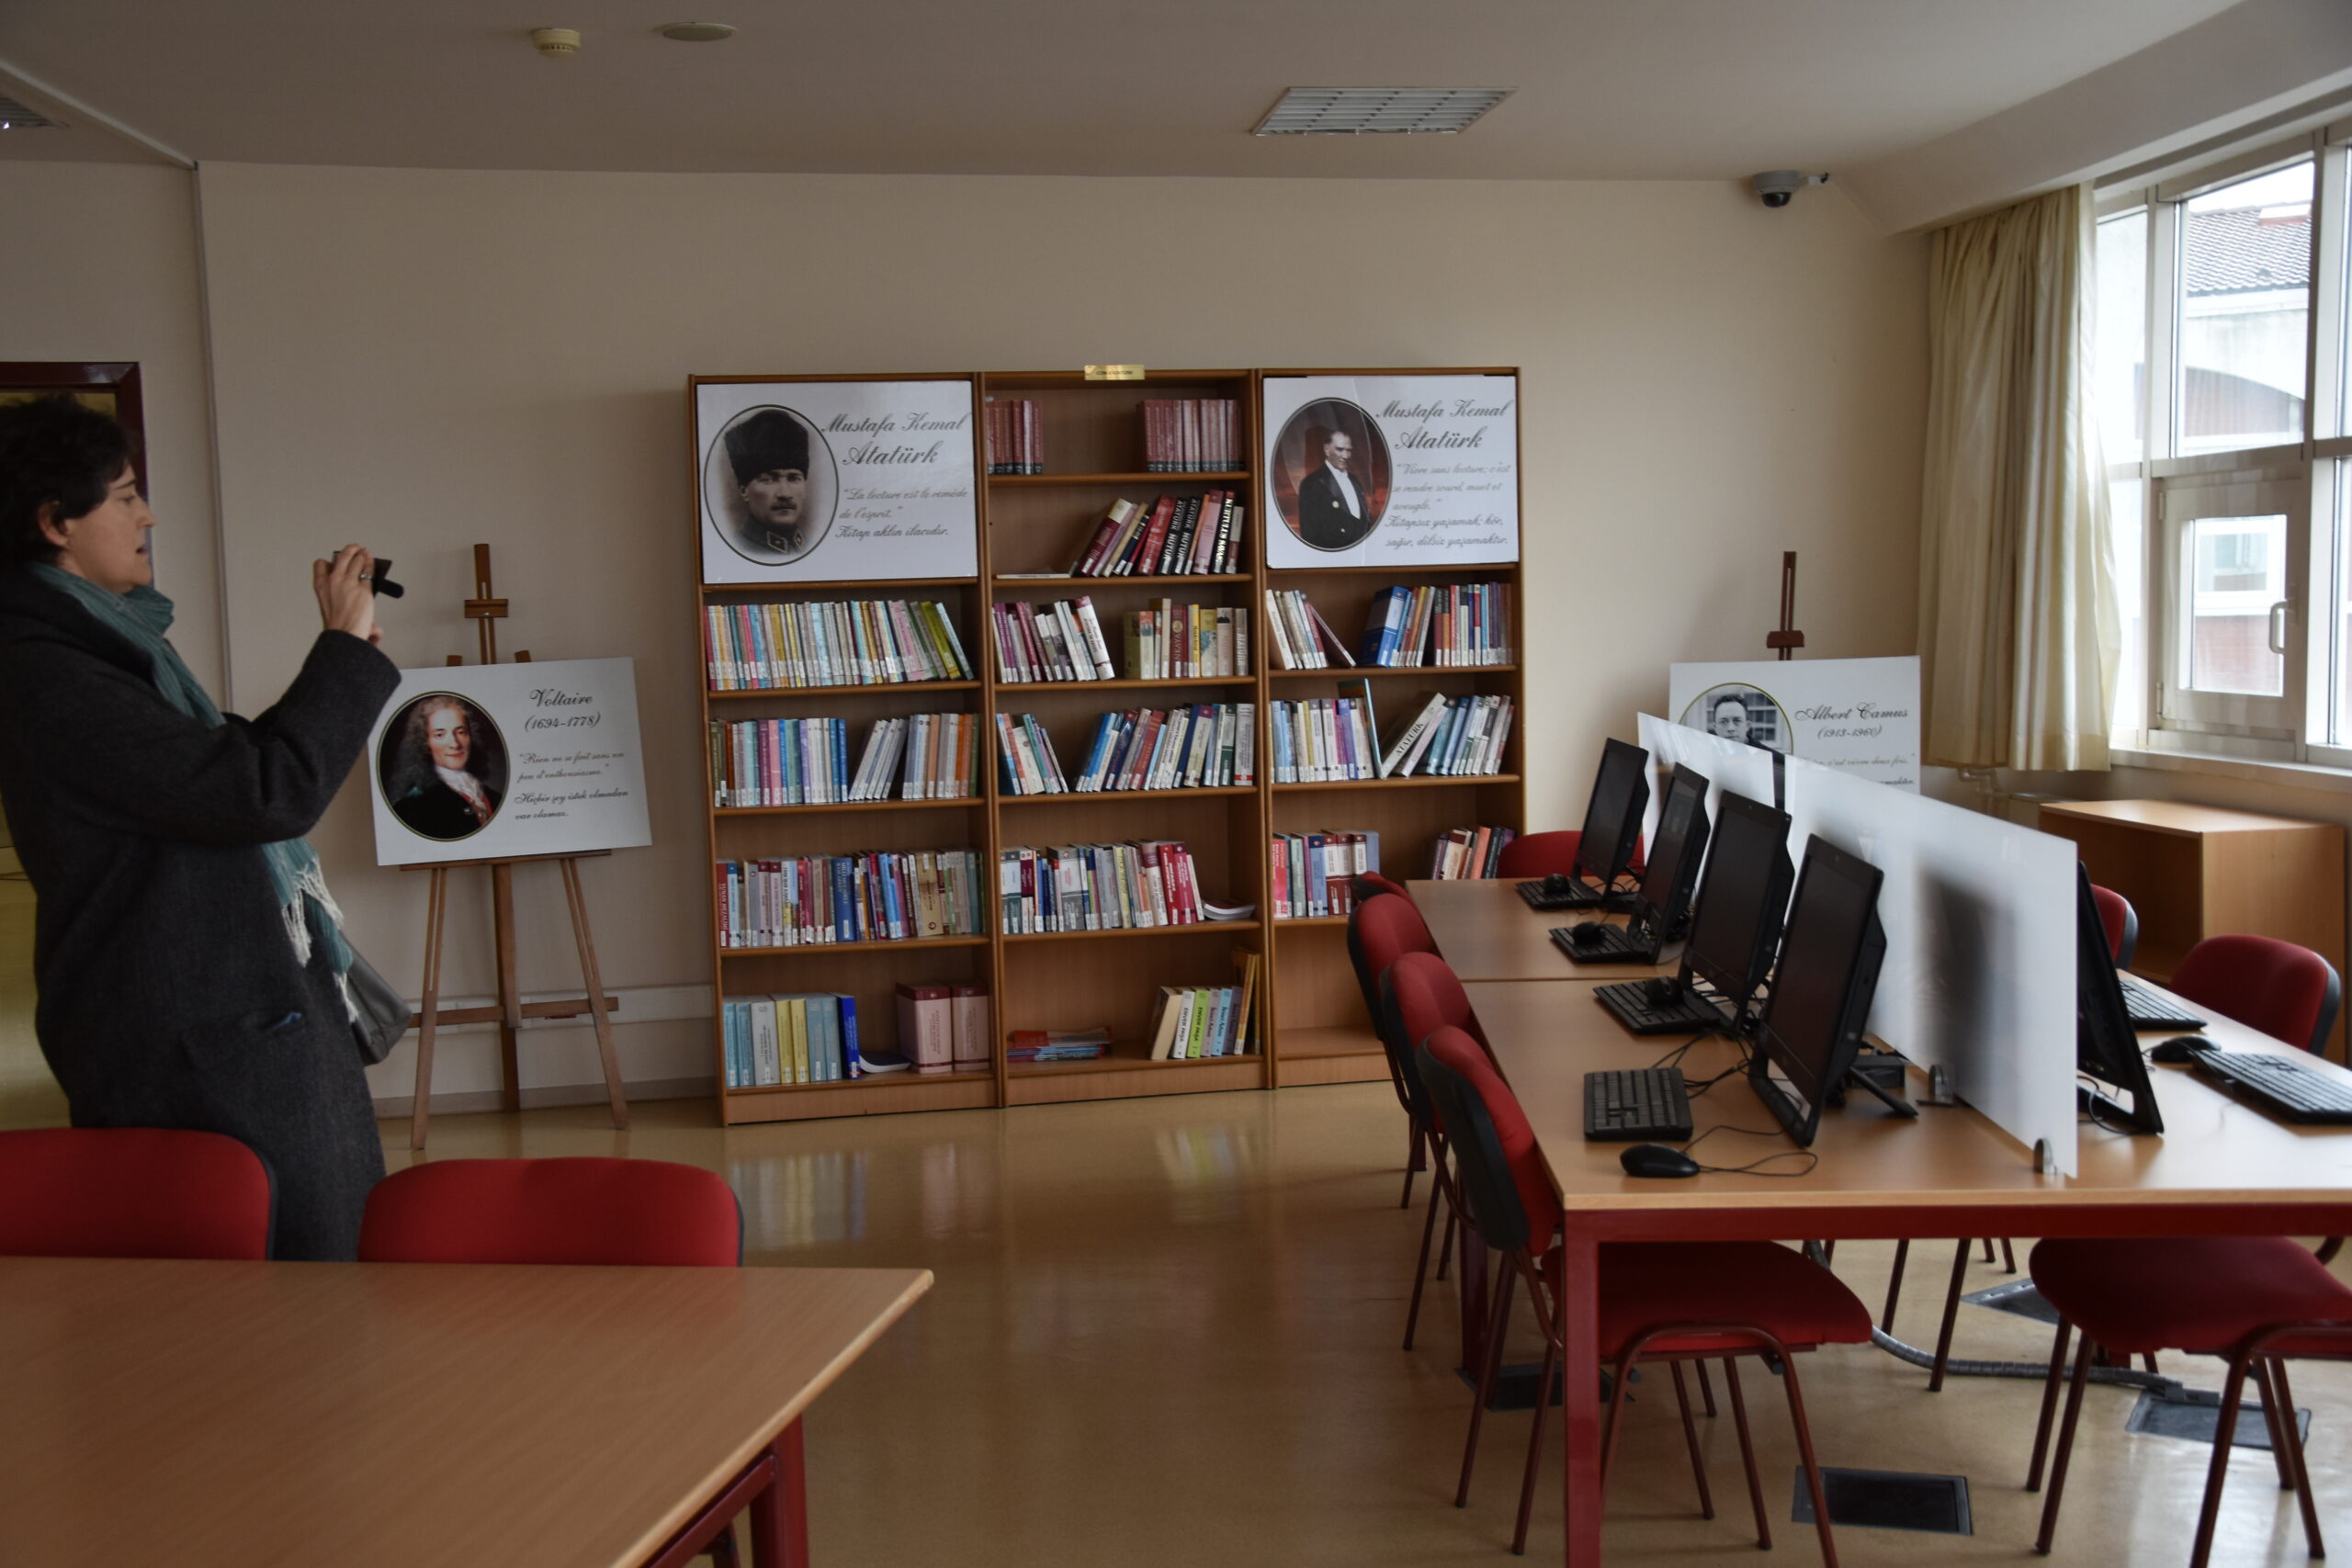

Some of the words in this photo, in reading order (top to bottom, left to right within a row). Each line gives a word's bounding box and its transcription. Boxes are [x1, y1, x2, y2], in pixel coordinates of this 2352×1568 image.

[1375, 400, 1444, 423] Mustafa
[1449, 399, 1514, 418] Kemal
[821, 413, 895, 437] Mustafa
[901, 412, 971, 432] Kemal
[1395, 425, 1487, 449] Atatürk
[842, 440, 944, 465] Atatürk
[866, 489, 900, 500] lecture
[835, 525, 870, 541] Kitap
[529, 688, 594, 707] Voltaire
[525, 711, 601, 732] (1694-1778)
[1794, 704, 1851, 721] Albert
[1856, 702, 1908, 719] Camus
